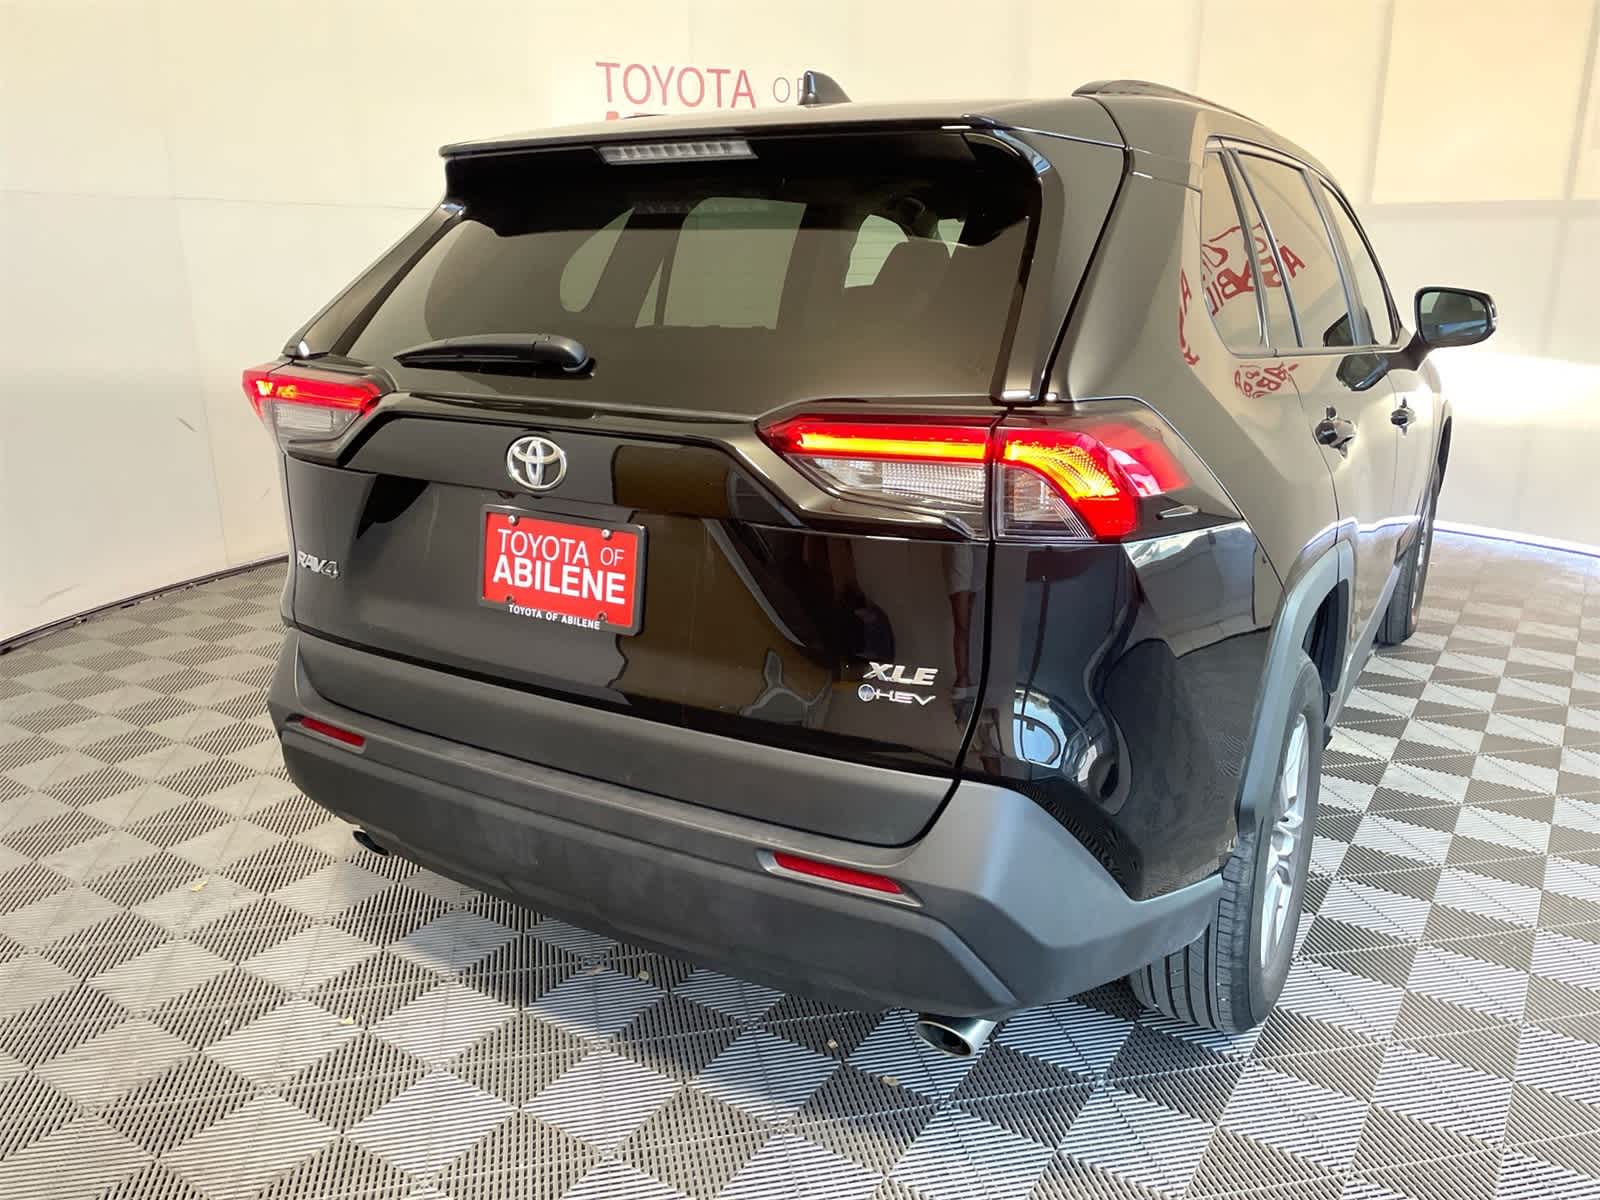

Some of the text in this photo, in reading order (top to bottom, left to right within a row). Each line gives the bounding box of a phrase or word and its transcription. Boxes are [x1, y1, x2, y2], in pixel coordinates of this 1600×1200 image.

[595, 61, 756, 109] TOYOTA
[498, 528, 625, 567] TOYOTA OF
[297, 550, 338, 578] RAV4
[493, 554, 626, 605] ABILENE
[508, 604, 600, 630] TOYOTA OF ABILENE
[862, 661, 938, 685] XLE
[875, 688, 936, 705] HEV
